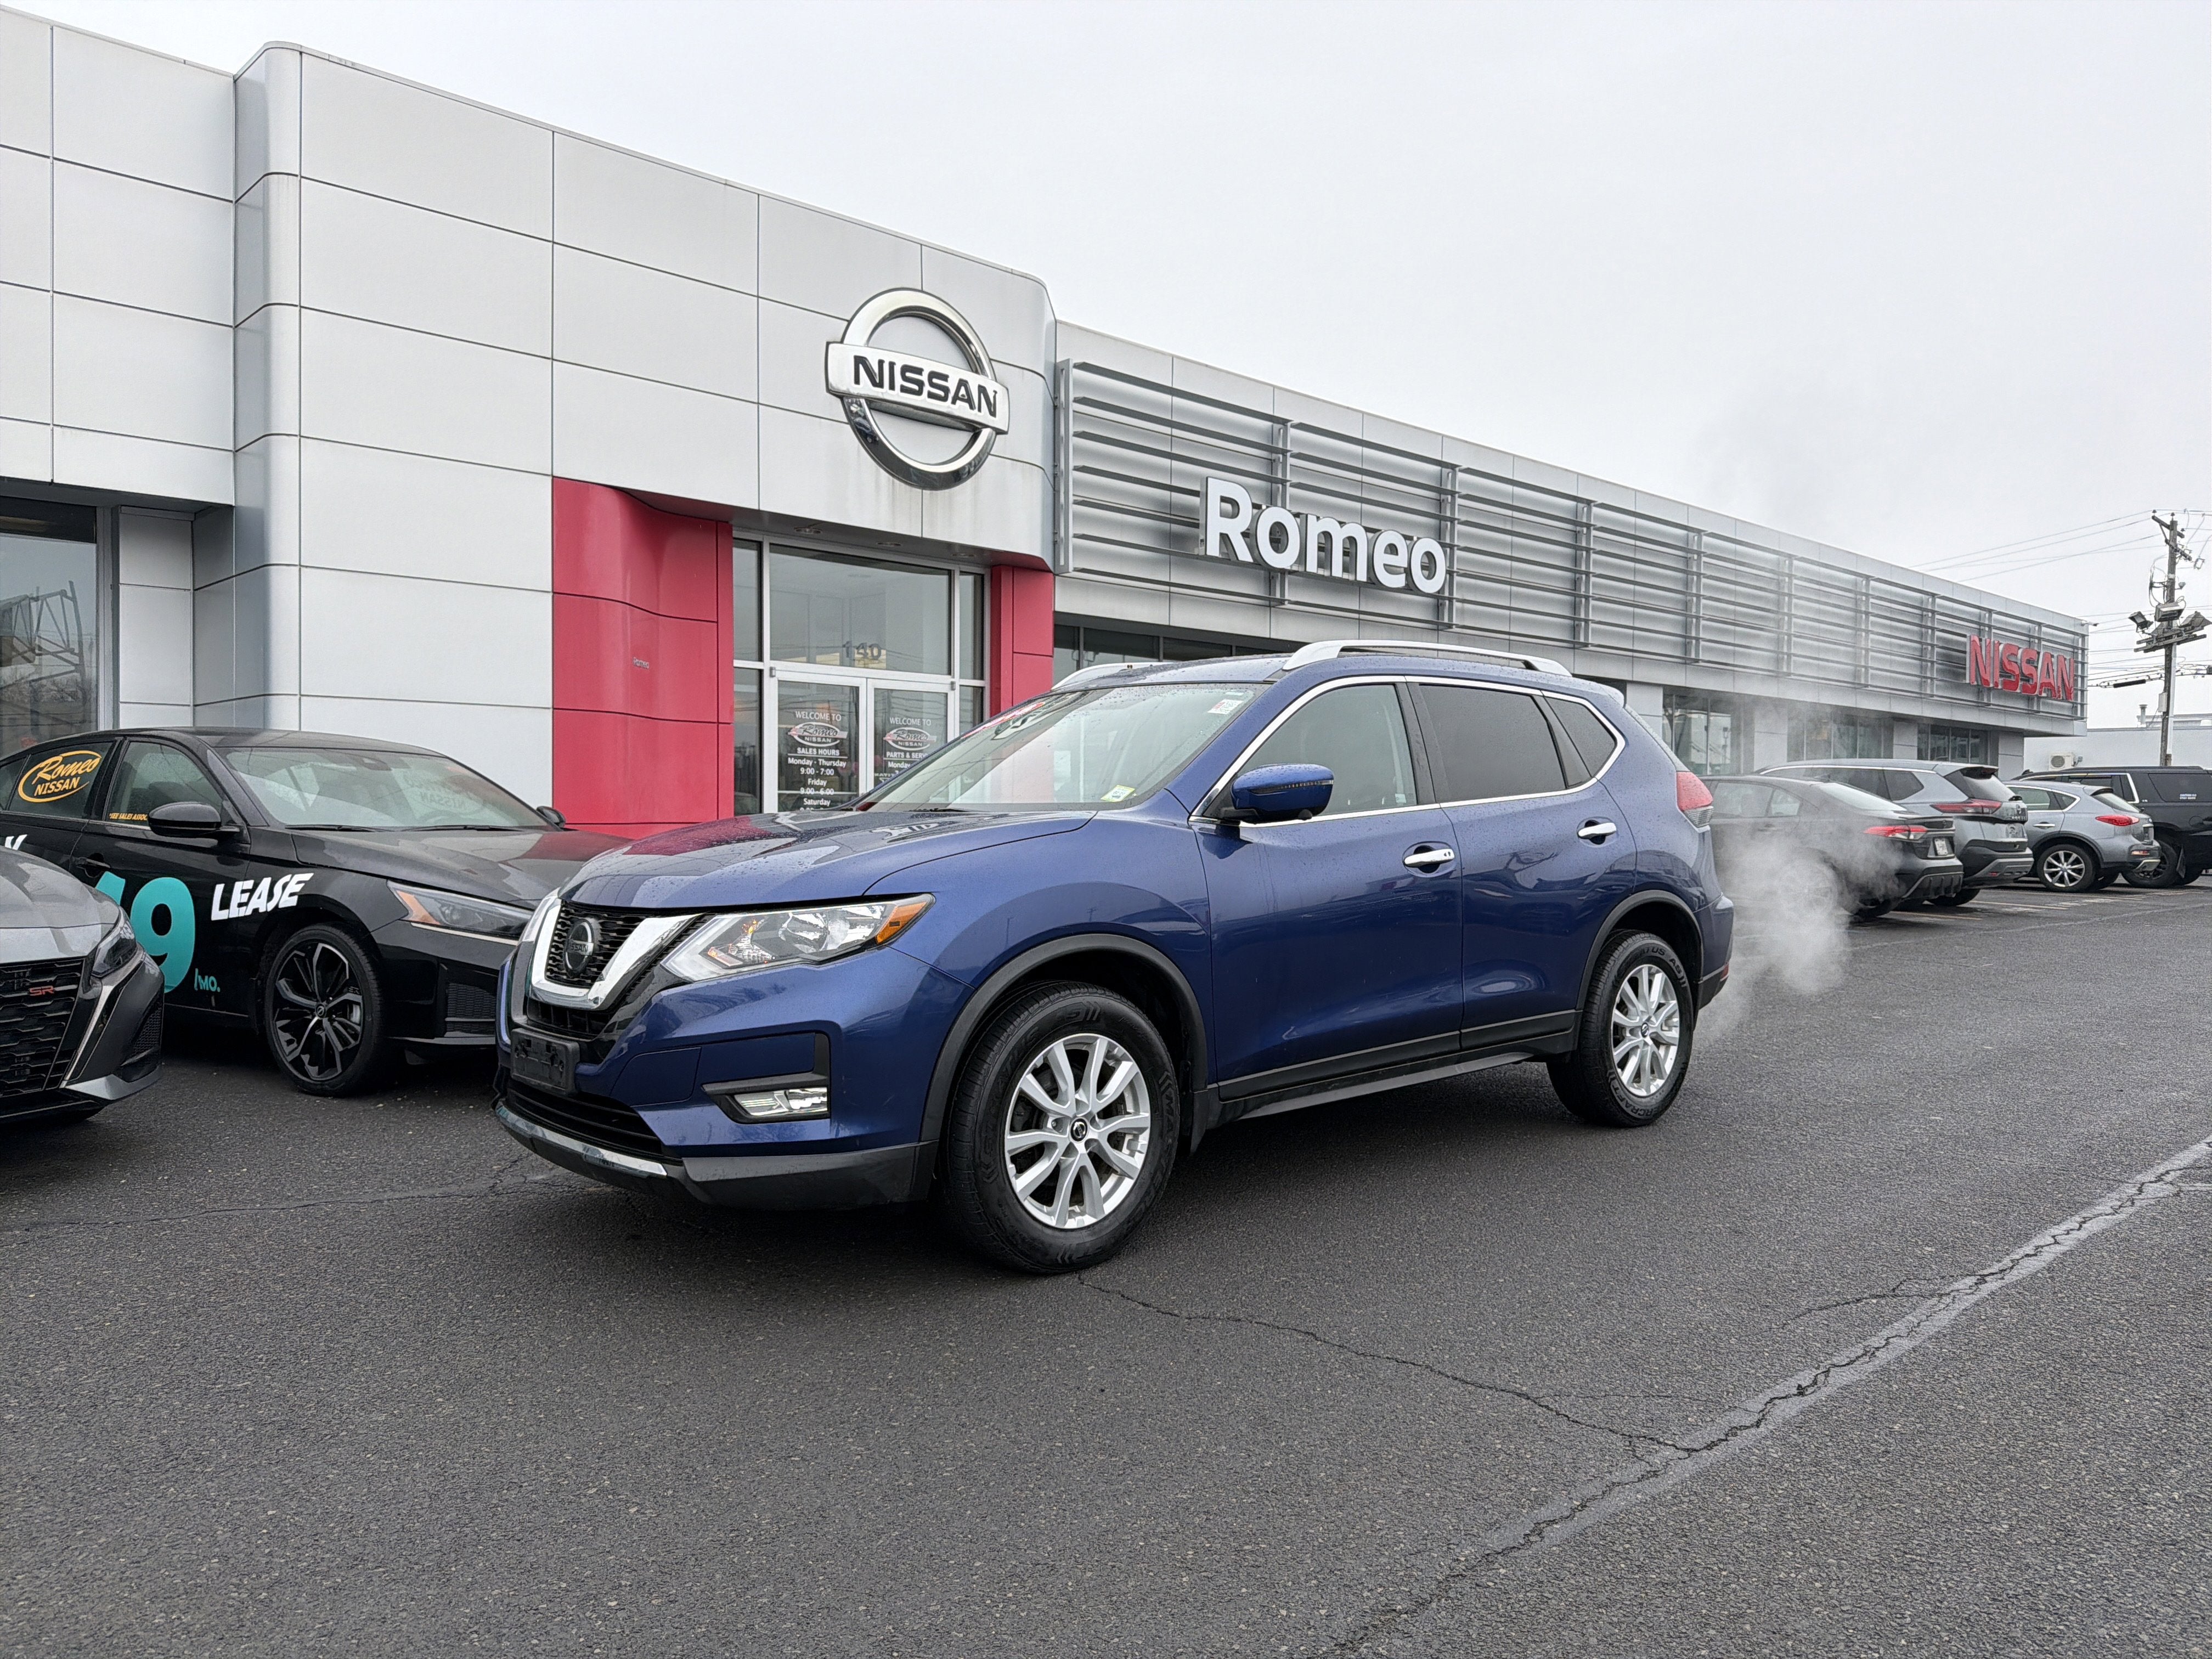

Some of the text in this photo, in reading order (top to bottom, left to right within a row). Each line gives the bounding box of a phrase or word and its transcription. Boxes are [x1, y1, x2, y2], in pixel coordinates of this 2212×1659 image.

[853, 355, 998, 418] NISSAN
[1201, 476, 1447, 594] Romeo
[842, 641, 881, 661] 140
[633, 656, 650, 669] Romeo
[1968, 634, 2075, 702] NISSAN
[795, 711, 830, 721] WELCOME
[799, 724, 838, 736] Romeo
[893, 729, 928, 740] Romeo
[31, 755, 101, 785] Romeo
[788, 757, 813, 766] Monday
[818, 759, 847, 768] Thursday
[34, 777, 81, 797] NISSAN
[808, 778, 827, 787] Friday
[803, 798, 831, 806] Saturday
[211, 872, 314, 921] LEASE
[194, 968, 221, 992] /MO.
[29, 985, 54, 996] SR
